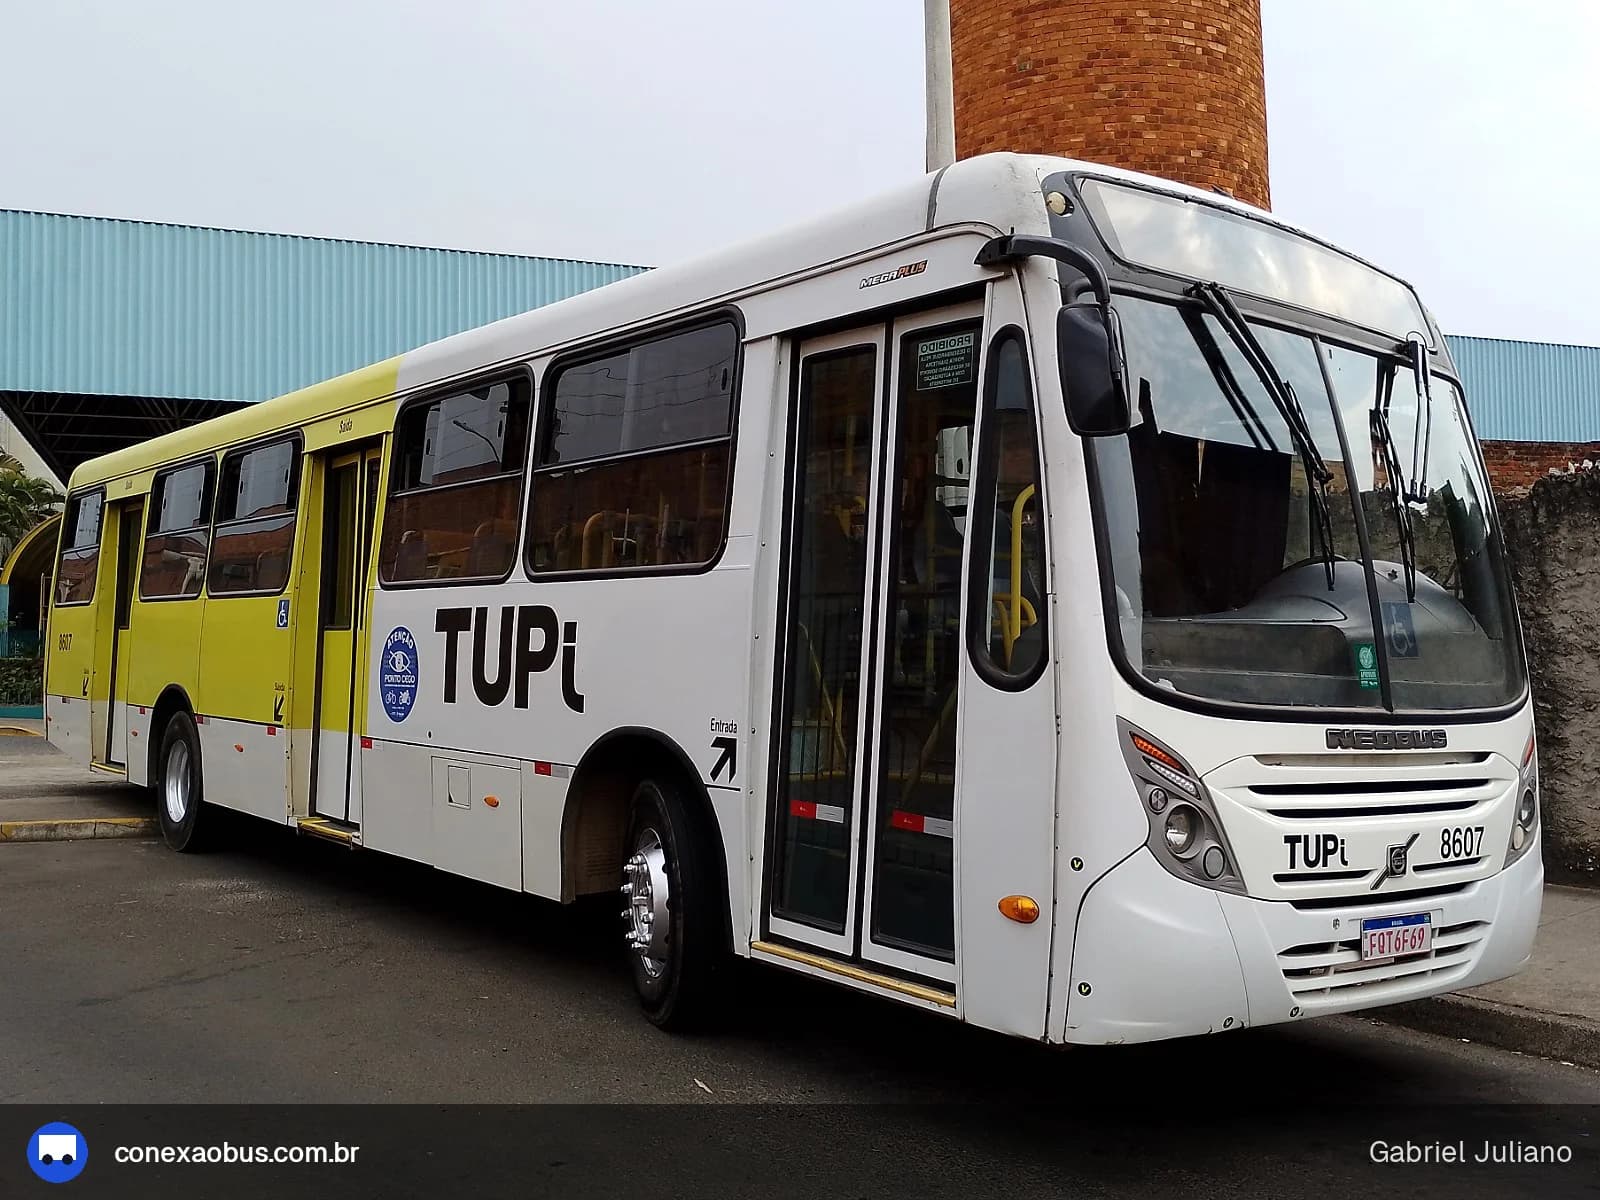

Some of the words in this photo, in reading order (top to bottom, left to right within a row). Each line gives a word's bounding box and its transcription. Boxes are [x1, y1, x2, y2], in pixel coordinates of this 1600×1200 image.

[384, 674, 401, 683] PONTO
[401, 674, 416, 684] CEGO
[710, 717, 738, 734] Entrada
[1325, 728, 1447, 749] NEOBUS
[1440, 826, 1485, 859] 8607
[1369, 927, 1425, 956] FQT6F69
